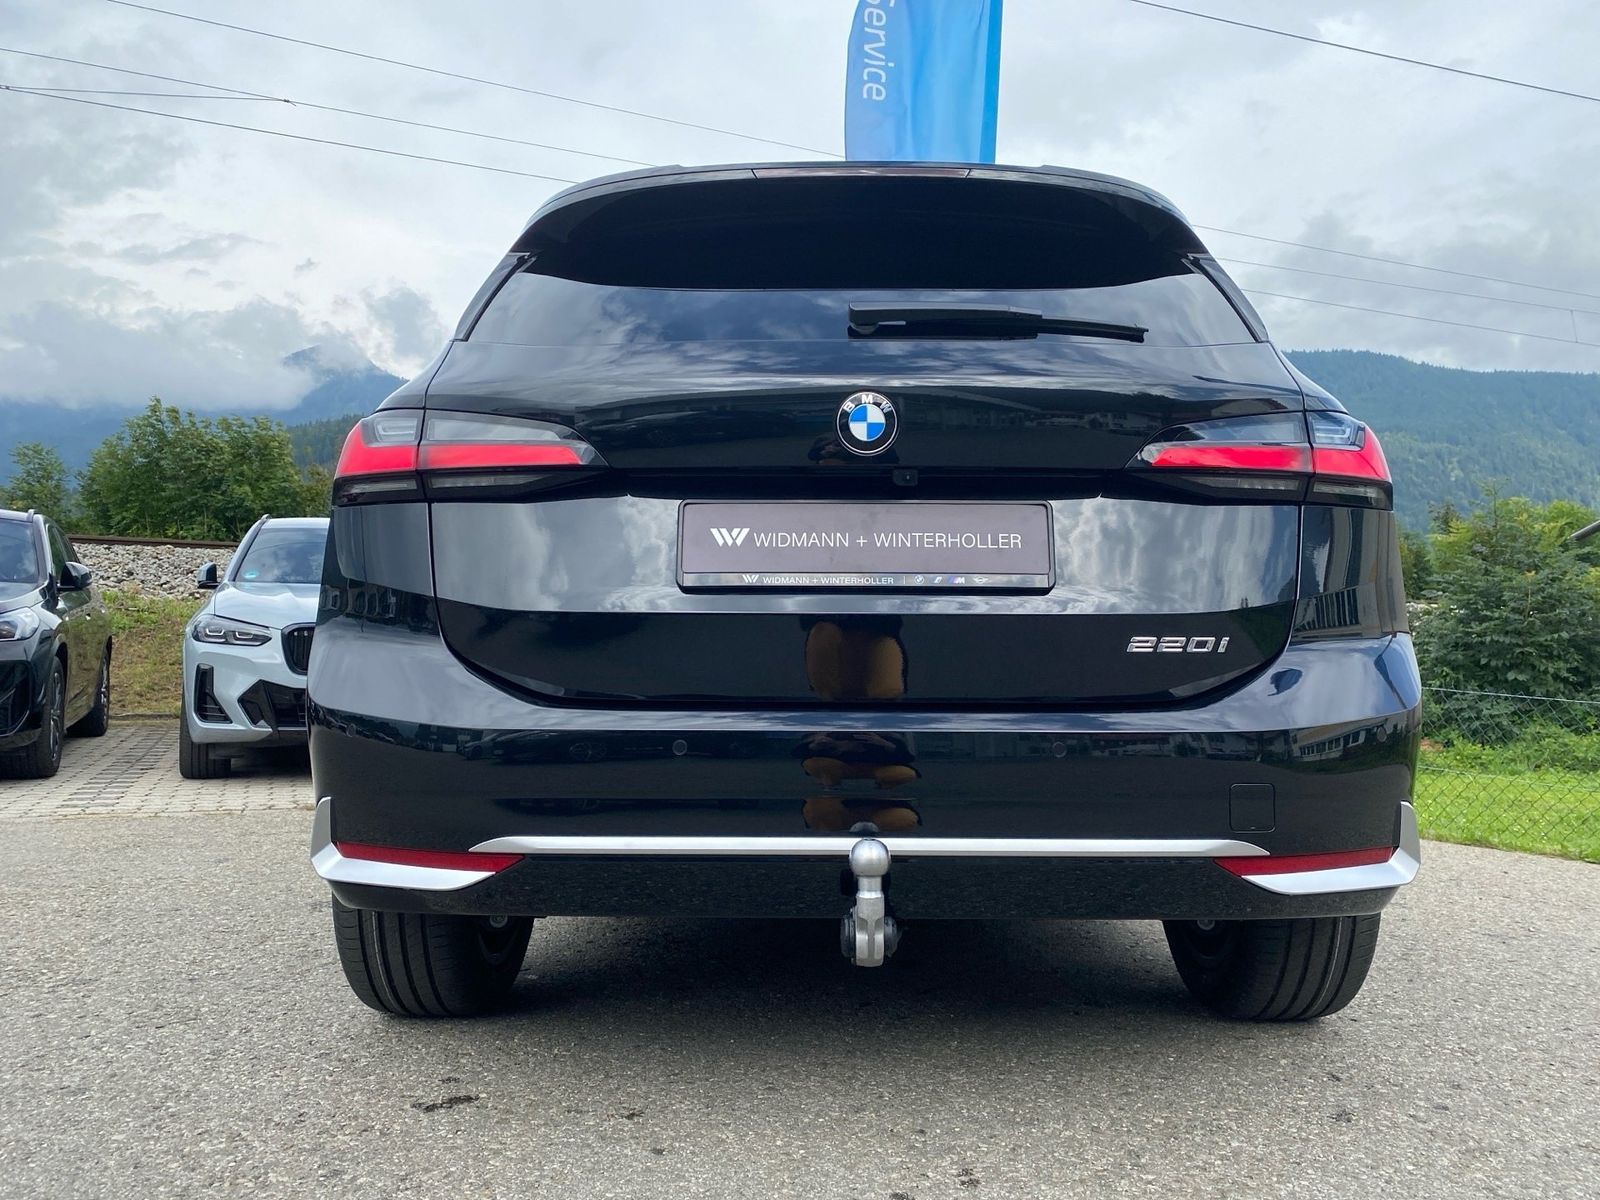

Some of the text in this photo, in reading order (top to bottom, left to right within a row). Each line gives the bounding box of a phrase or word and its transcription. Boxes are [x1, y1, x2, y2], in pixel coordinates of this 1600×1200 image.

[843, 394, 893, 413] BMW
[753, 532, 849, 548] WIDMANN
[873, 532, 1023, 549] WINTERHOLLER
[762, 575, 810, 585] WIDMANN
[820, 576, 894, 585] WINTERHOLLER
[1126, 636, 1230, 653] 220i
